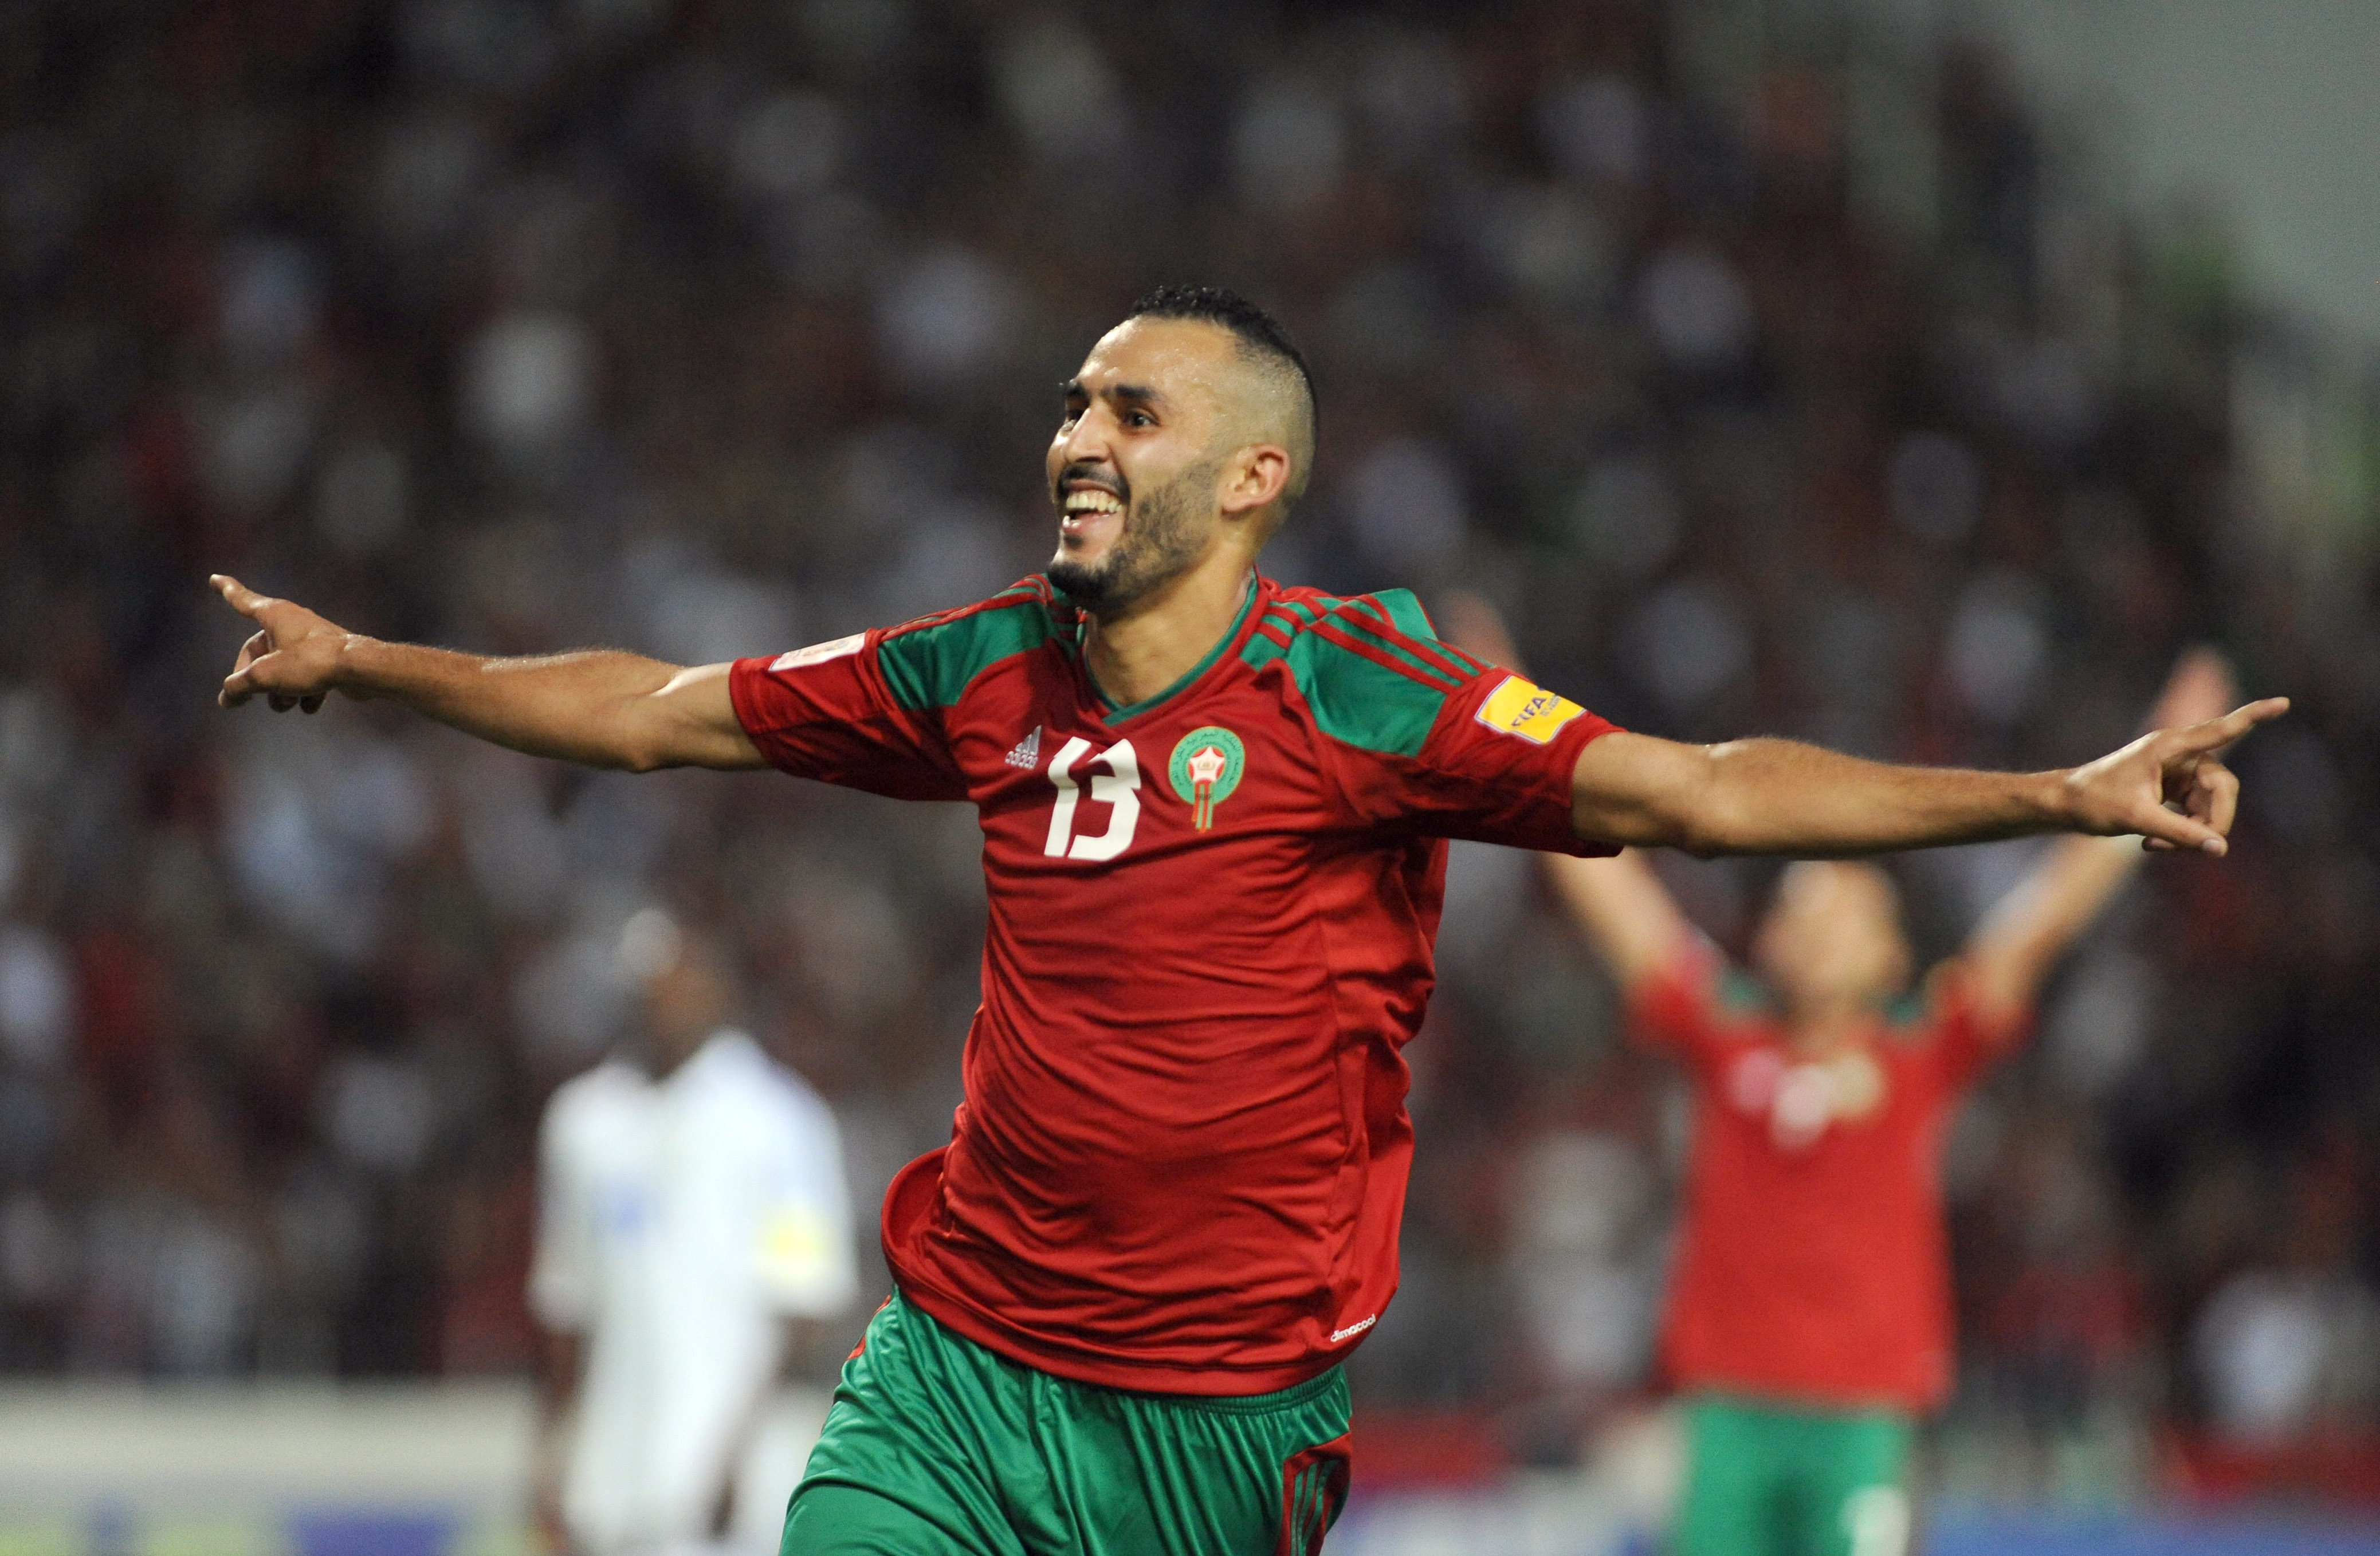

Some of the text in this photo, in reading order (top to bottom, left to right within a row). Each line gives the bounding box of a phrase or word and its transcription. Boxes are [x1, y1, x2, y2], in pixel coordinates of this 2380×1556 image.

[1511, 697, 1546, 726] FIFA
[1005, 748, 1038, 769] adidas
[1044, 736, 1141, 862] 13
[1330, 1313, 1376, 1342] climacool
